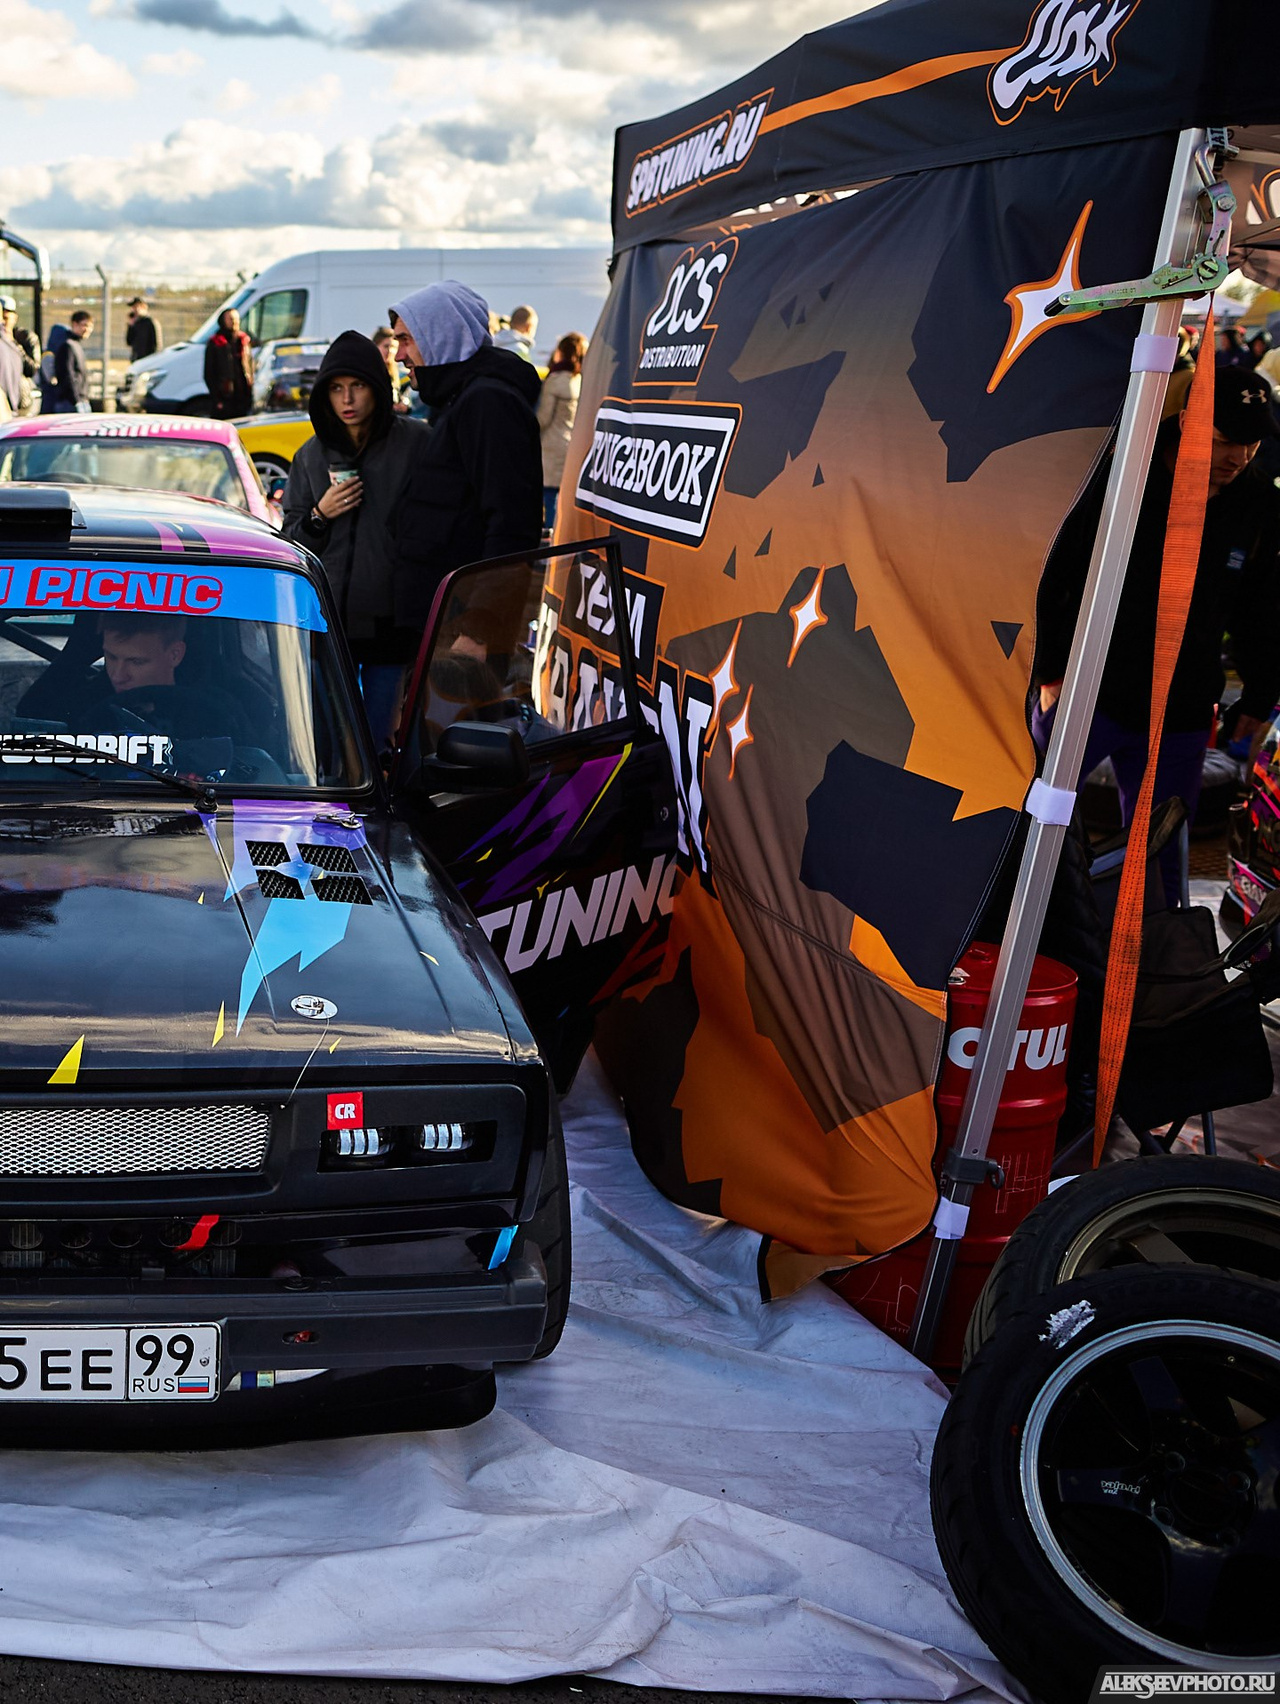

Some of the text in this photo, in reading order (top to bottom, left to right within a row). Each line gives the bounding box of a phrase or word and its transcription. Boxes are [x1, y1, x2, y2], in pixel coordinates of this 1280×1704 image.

[626, 101, 767, 210] SPBTUNING.RU
[646, 252, 727, 337] DCS
[639, 344, 705, 370] DISTRIBUTION
[25, 566, 223, 615] PICNIC
[334, 1102, 356, 1120] CR
[134, 1333, 195, 1377] 99
[132, 1377, 176, 1394] RUS
